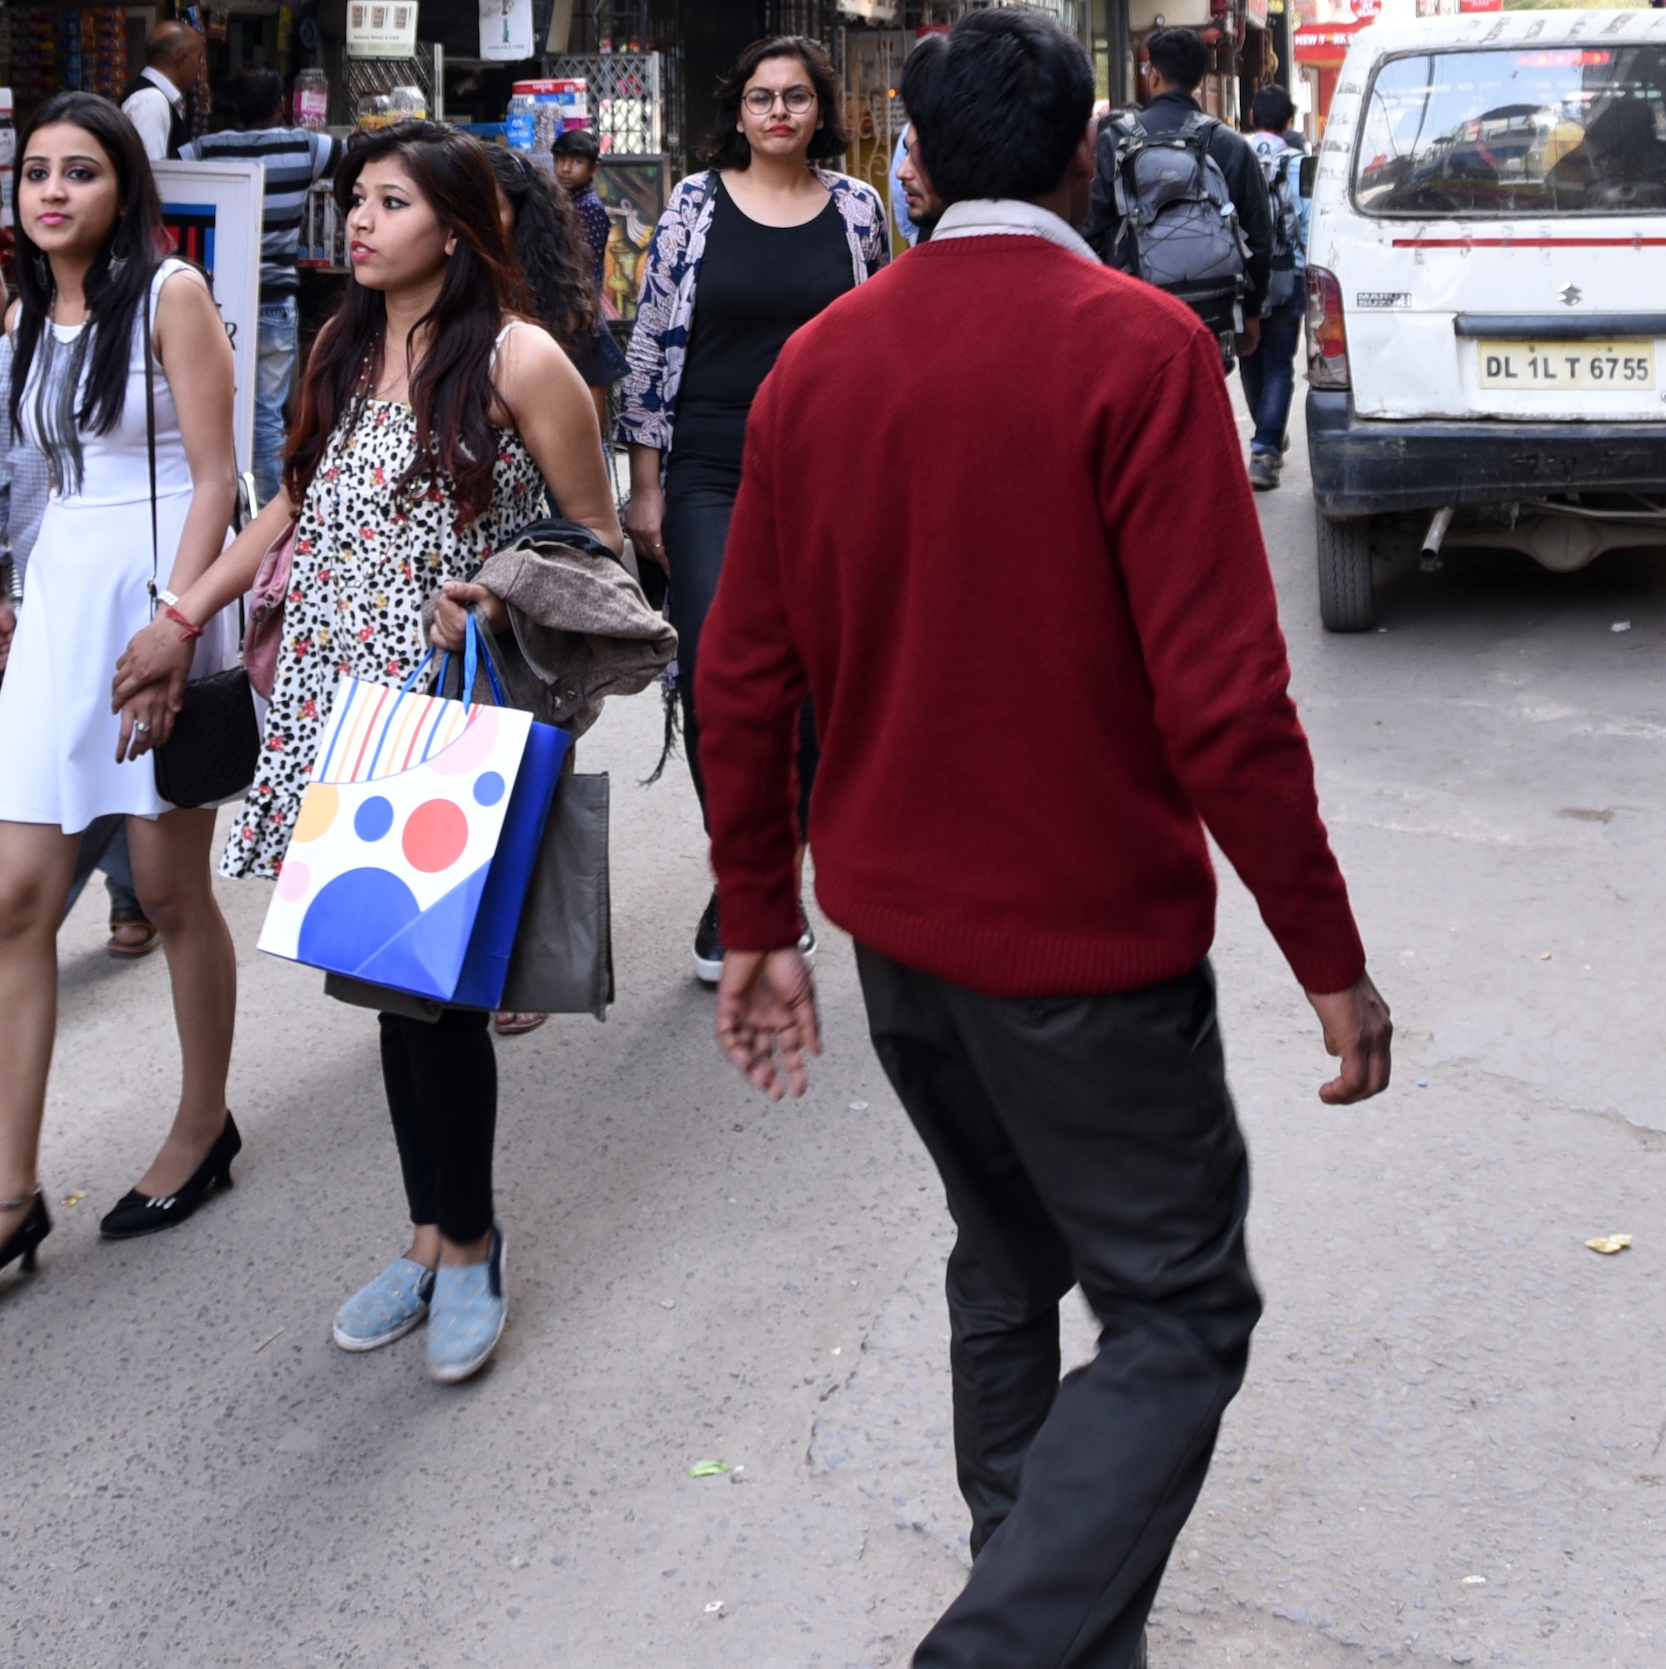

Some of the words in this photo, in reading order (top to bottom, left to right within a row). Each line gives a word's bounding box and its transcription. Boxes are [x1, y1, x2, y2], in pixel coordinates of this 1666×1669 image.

[1294, 34, 1318, 46] NEW
[1485, 355, 1519, 380] DL
[1527, 356, 1558, 381] 1L
[1564, 356, 1582, 381] T
[1589, 355, 1650, 382] 6755
